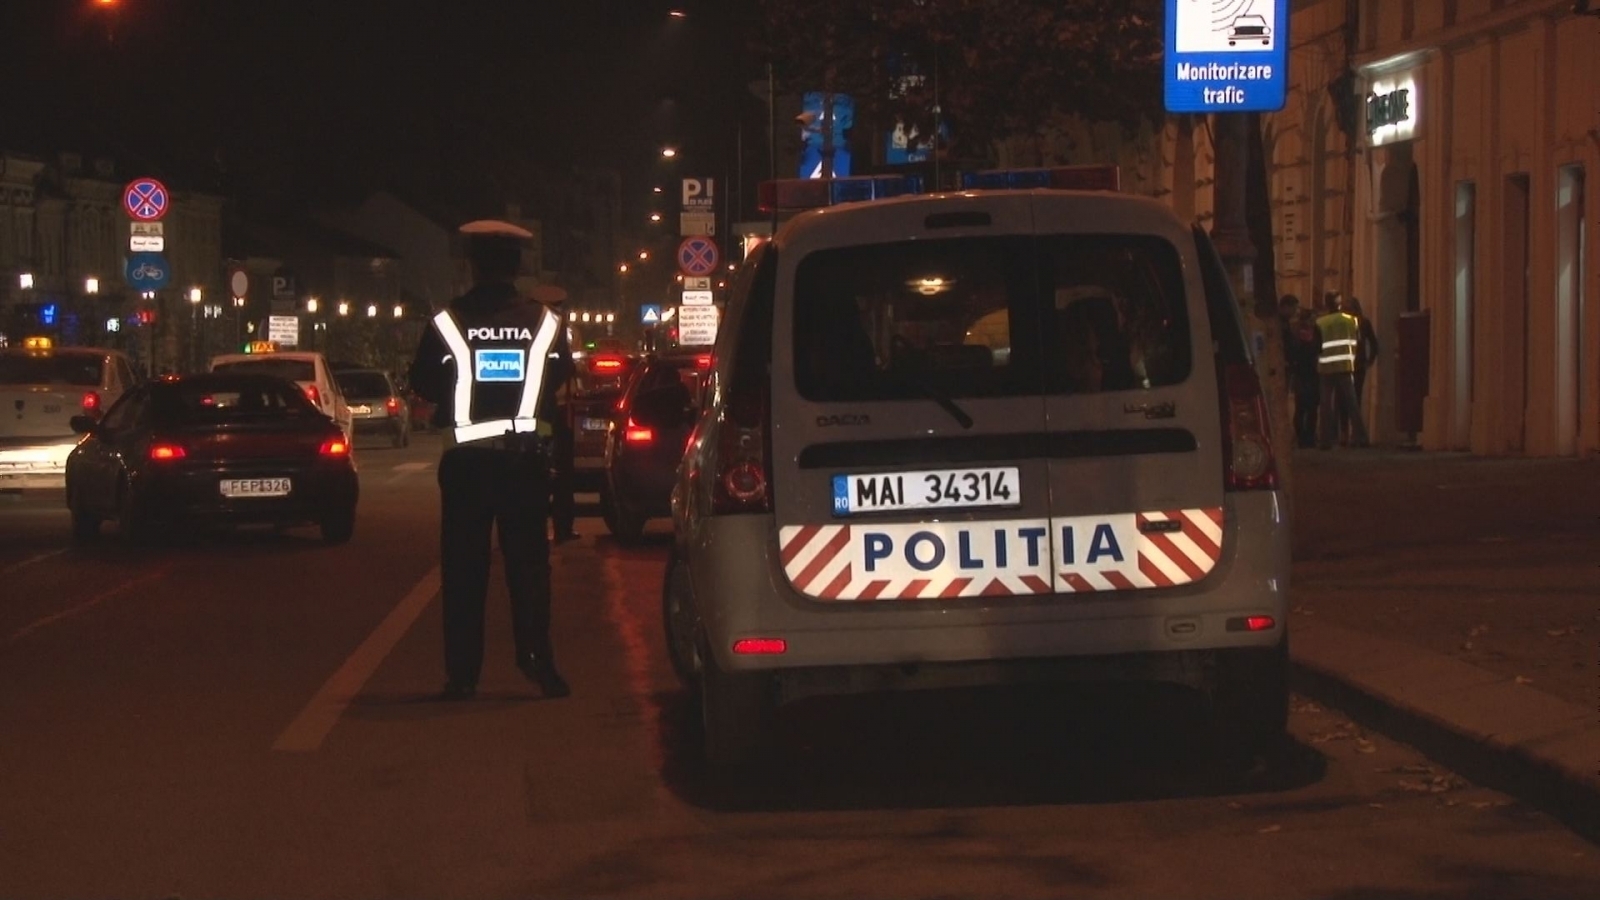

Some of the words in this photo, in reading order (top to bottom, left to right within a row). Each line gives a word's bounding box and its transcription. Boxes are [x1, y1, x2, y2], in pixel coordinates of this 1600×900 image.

[1177, 62, 1272, 80] Monitorizare
[1203, 86, 1245, 104] trafic
[467, 327, 532, 340] POLITIA
[480, 360, 520, 371] POLITIA
[856, 475, 904, 507] MAI
[924, 471, 1011, 503] 34314
[834, 497, 848, 509] RO
[863, 522, 1125, 573] POLITIA
